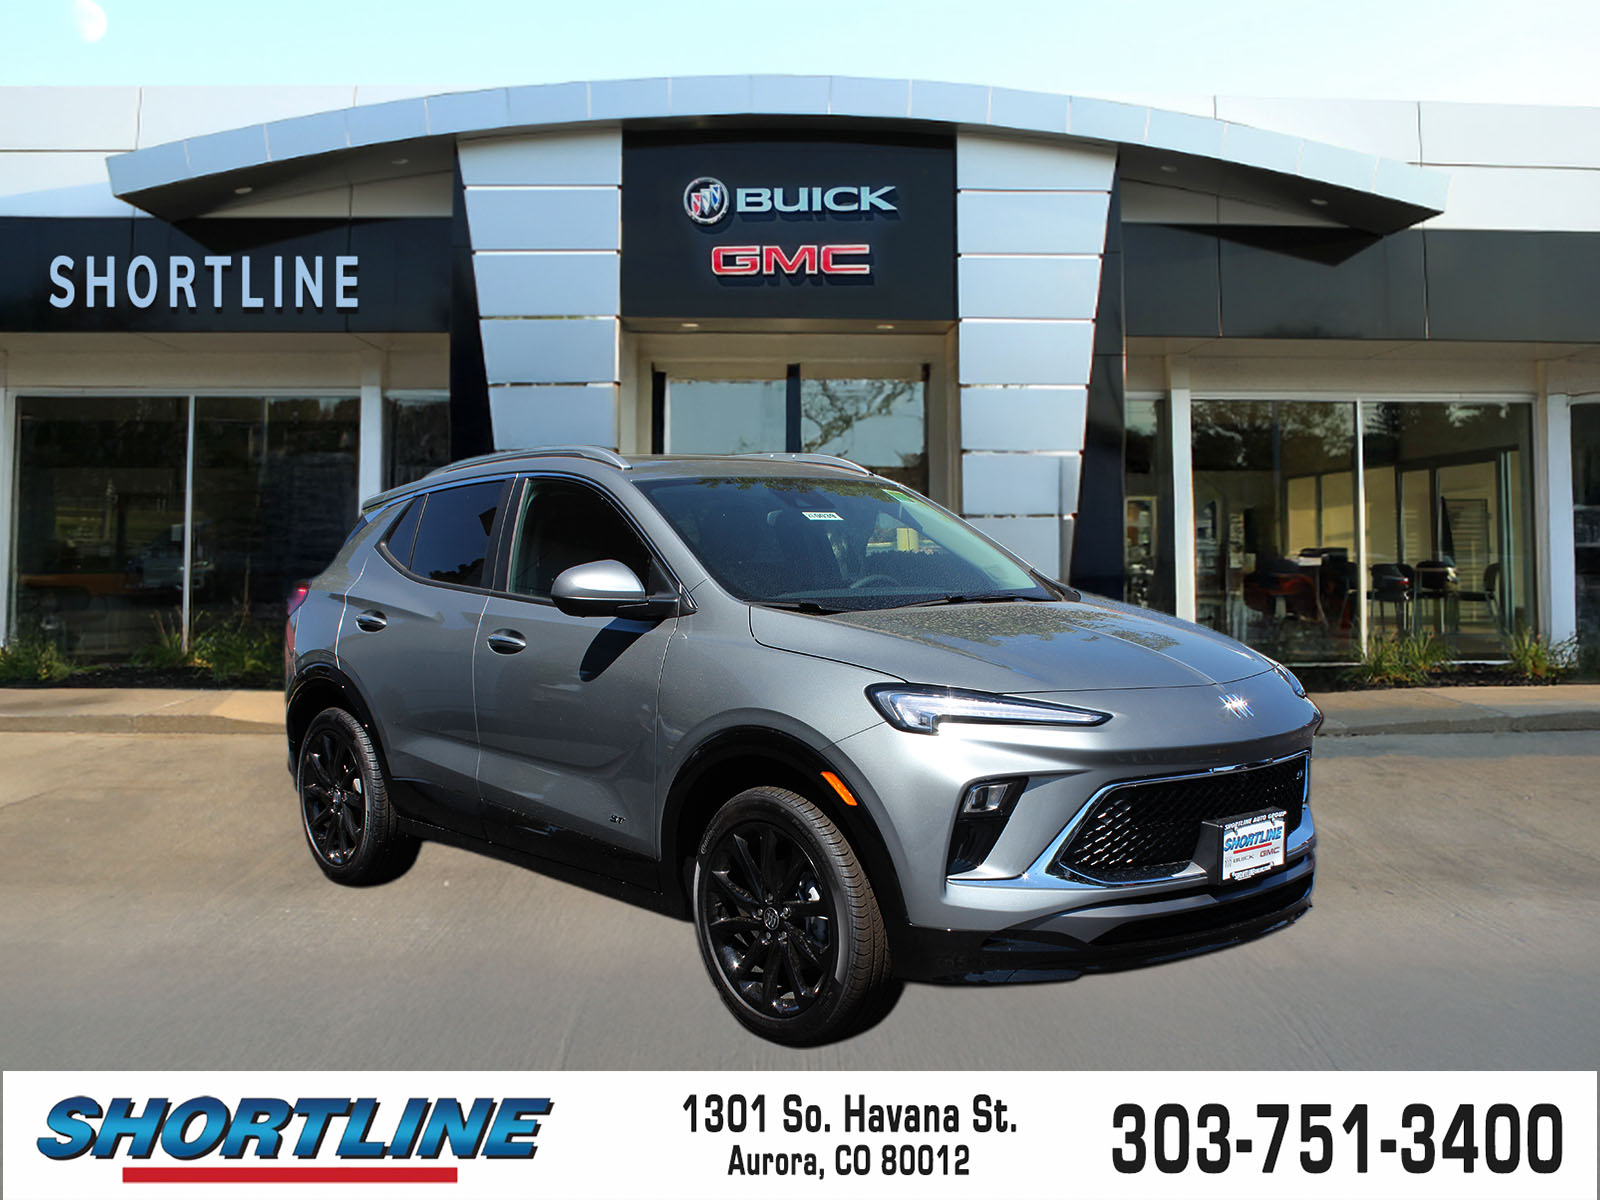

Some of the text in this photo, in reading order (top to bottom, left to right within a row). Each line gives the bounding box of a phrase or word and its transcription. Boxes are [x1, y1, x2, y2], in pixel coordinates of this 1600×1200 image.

[736, 185, 898, 213] BUICK
[711, 244, 870, 276] GMC
[49, 254, 360, 309] SHORTLINE
[1225, 818, 1252, 830] SHORTLINE
[1253, 814, 1267, 823] AUTO
[1223, 826, 1282, 852] SHORTLINE
[1233, 846, 1280, 863] BUICK GMC
